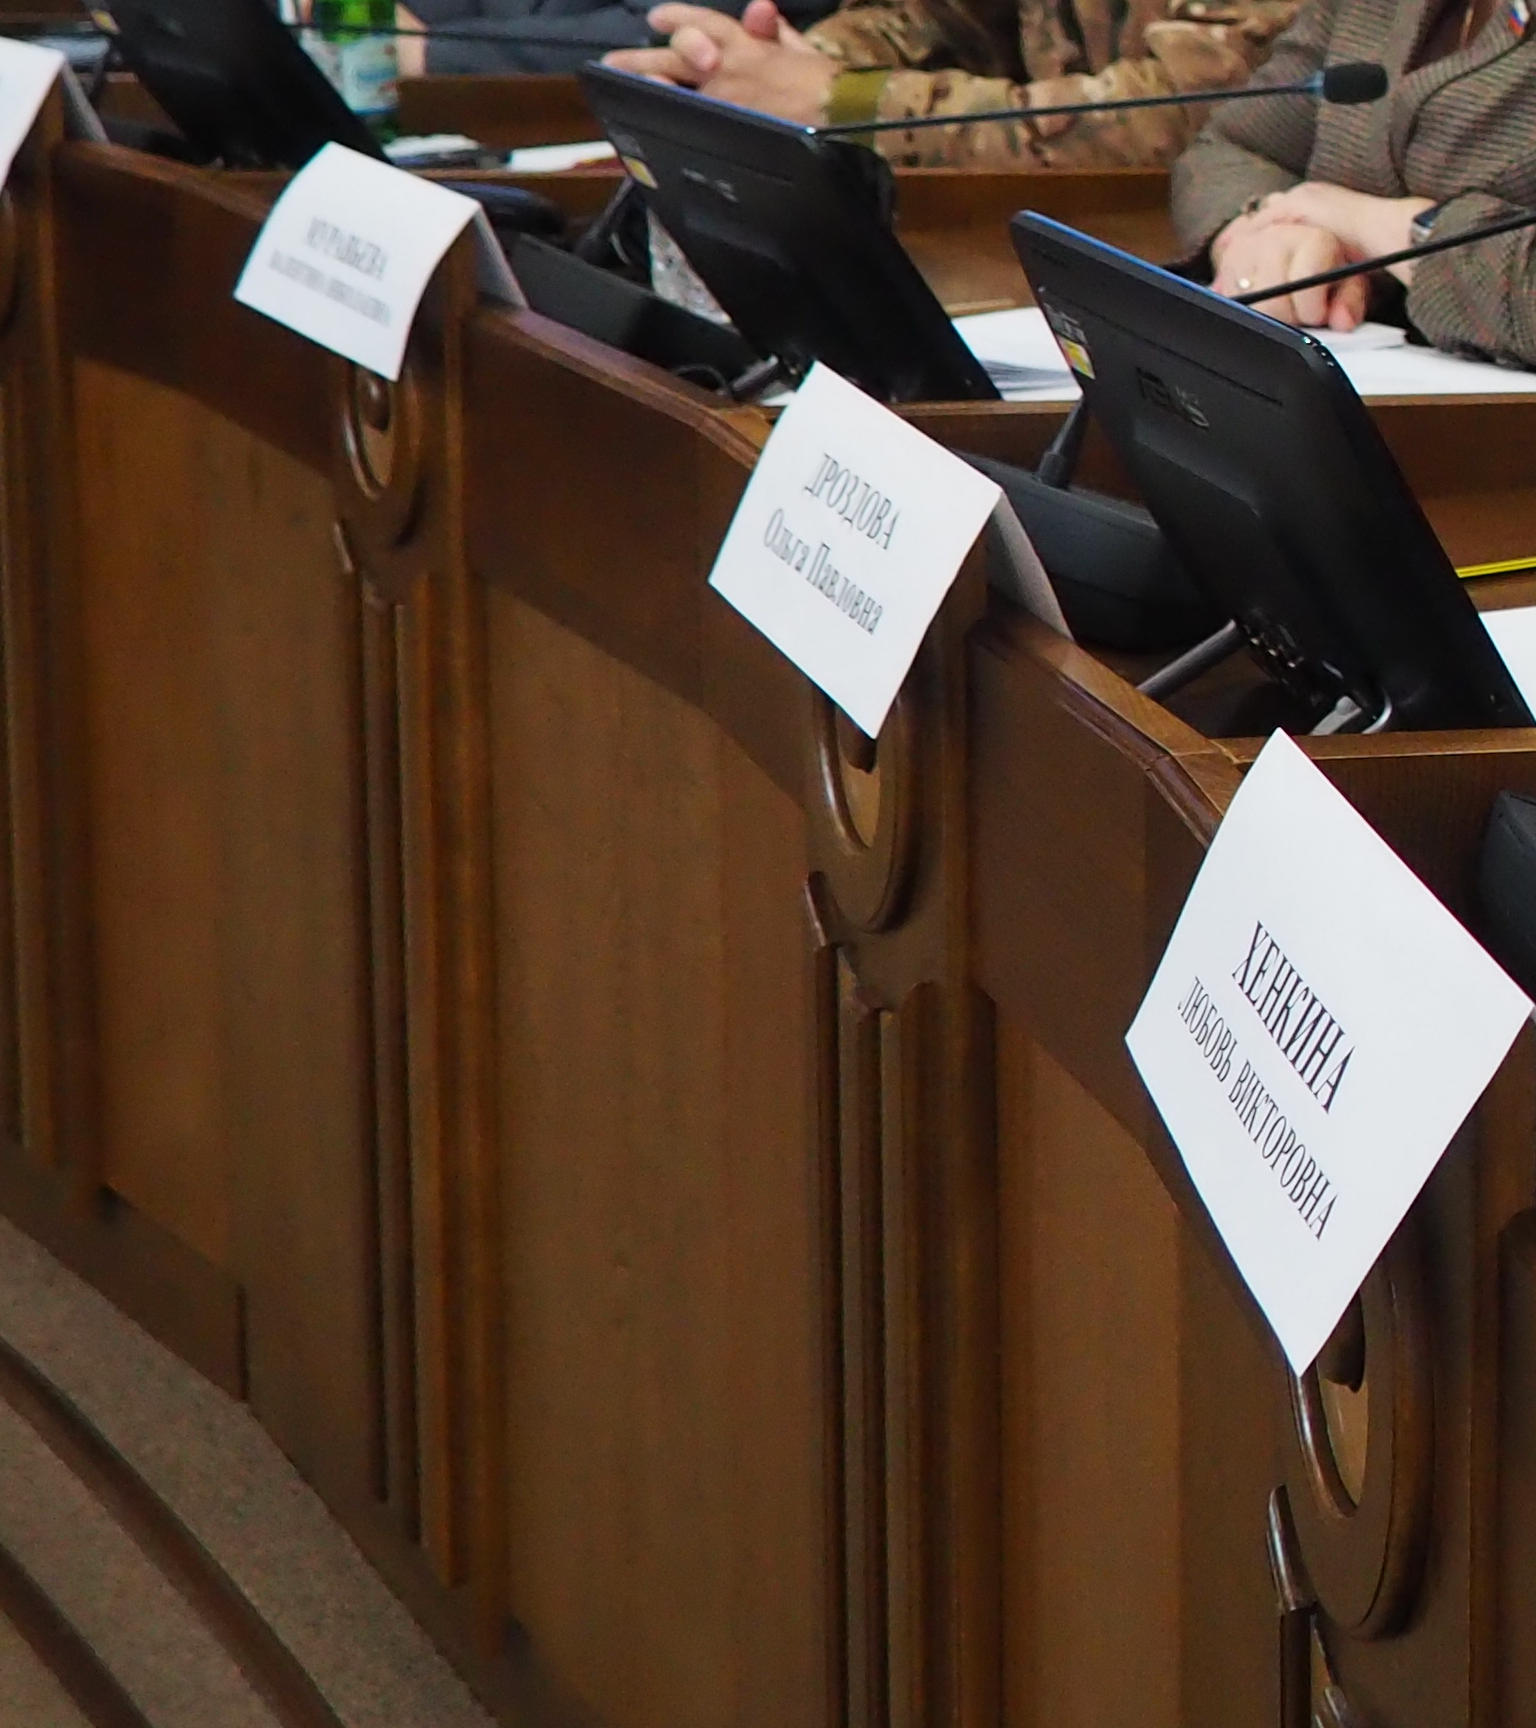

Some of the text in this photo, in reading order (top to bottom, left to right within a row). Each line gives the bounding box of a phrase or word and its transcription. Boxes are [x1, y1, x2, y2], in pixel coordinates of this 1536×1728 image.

[763, 507, 884, 636] Ольга Павловна
[804, 452, 901, 551] ДРОЗДОВА
[1231, 919, 1358, 1115] ХЕНКИНА
[1176, 974, 1341, 1242] ЛЮБОВЬ ВИКТОРОВНА
